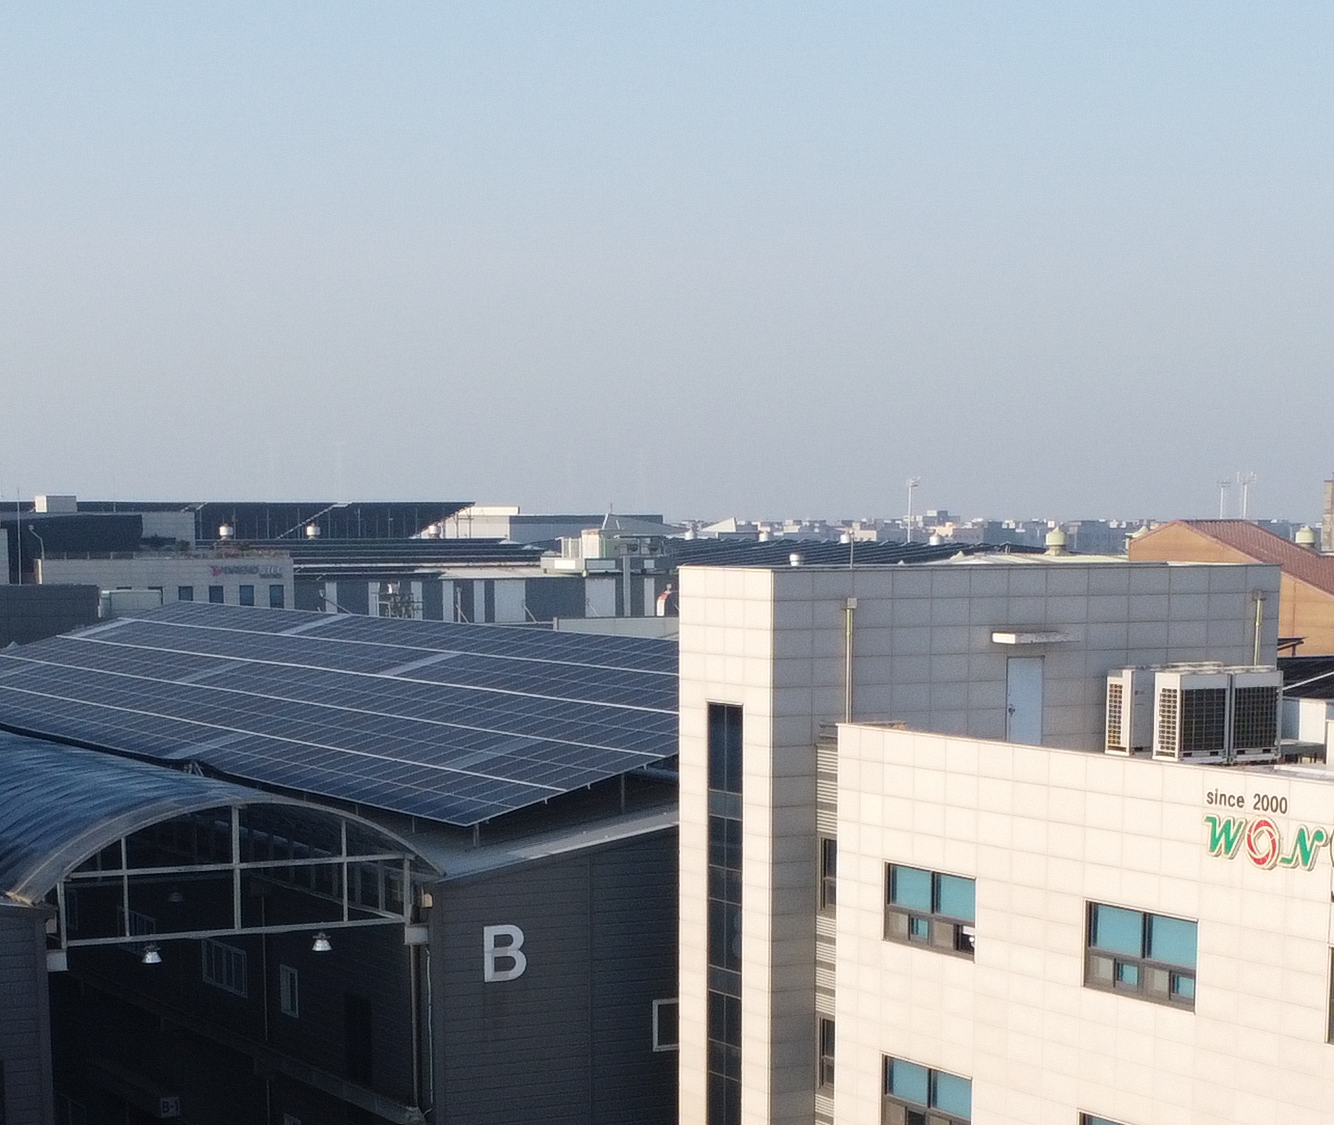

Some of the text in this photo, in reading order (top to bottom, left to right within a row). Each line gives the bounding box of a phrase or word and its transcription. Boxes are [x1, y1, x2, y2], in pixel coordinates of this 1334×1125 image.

[1206, 789, 1288, 815] since 2000
[1204, 814, 1328, 871] WON
[483, 924, 527, 984] B
